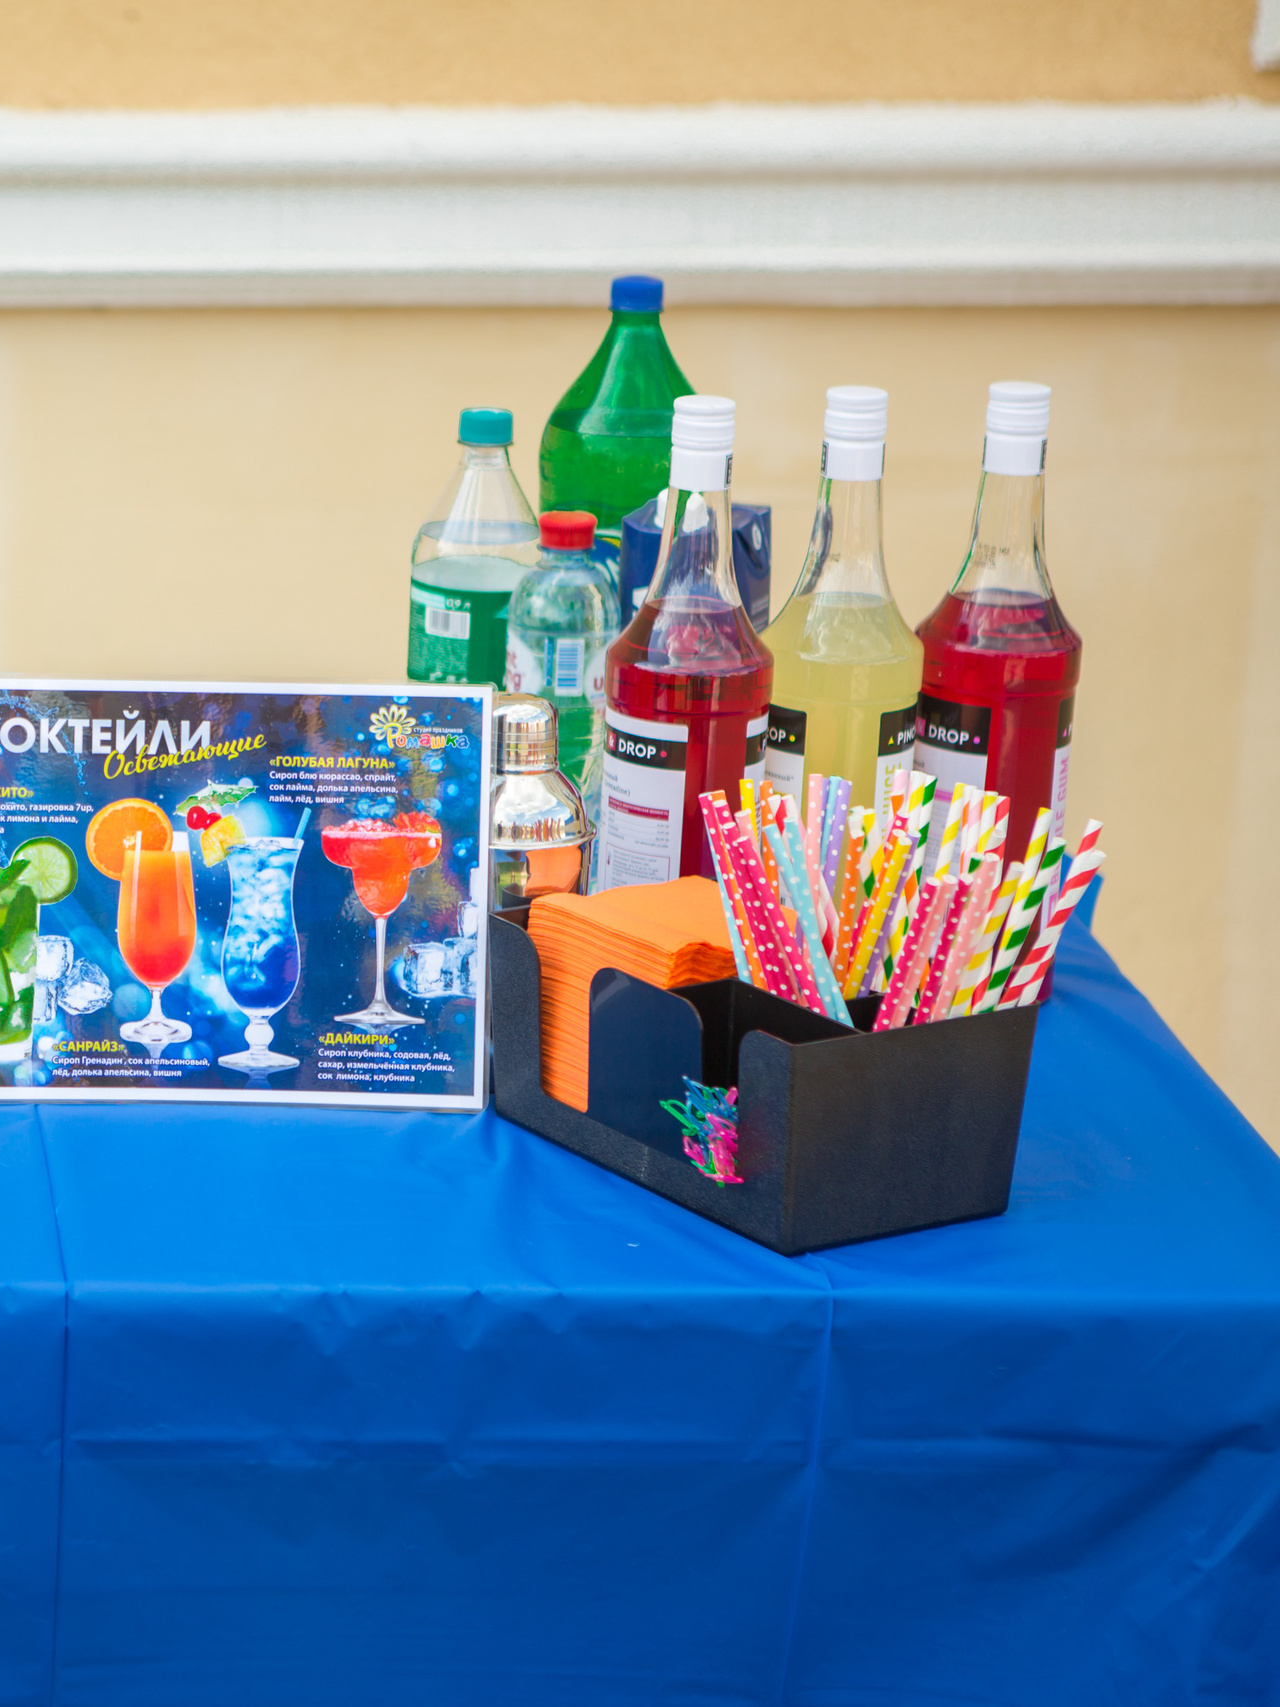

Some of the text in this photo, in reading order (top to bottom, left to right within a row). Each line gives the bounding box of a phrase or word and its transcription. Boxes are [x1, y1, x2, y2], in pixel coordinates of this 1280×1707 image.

[384, 722, 470, 750] Ромашка
[897, 729, 916, 746] PINC
[928, 724, 970, 746] DROP
[618, 737, 657, 760] DROP
[103, 733, 268, 780] Освежающие
[269, 756, 395, 769] «ГОЛУБАЯ ЛАГУНА»
[269, 771, 396, 783] Сироп блю кюрассао, спрайт,
[285, 783, 316, 793] лайма,
[316, 785, 348, 794] долька
[349, 785, 399, 794] апельсина,
[268, 795, 345, 804] лайм, лёд, вишня
[29, 803, 74, 813] газировка
[75, 803, 95, 814] 7up,
[48, 815, 79, 824] лайма,
[318, 1031, 395, 1046] «ДАЙКИРИ»
[52, 1039, 125, 1052] «САНРАЙЗ»
[318, 1048, 452, 1062] Сироп клубника, содовая, лёд,
[52, 1056, 80, 1066] Сироп
[144, 1057, 210, 1067] апельсиновый,
[317, 1061, 456, 1073] сахар, измельчённая клубника,
[52, 1068, 70, 1077] лёд,
[71, 1069, 102, 1077] долька
[103, 1069, 152, 1078] апельсина,
[373, 1073, 416, 1083] клубника
